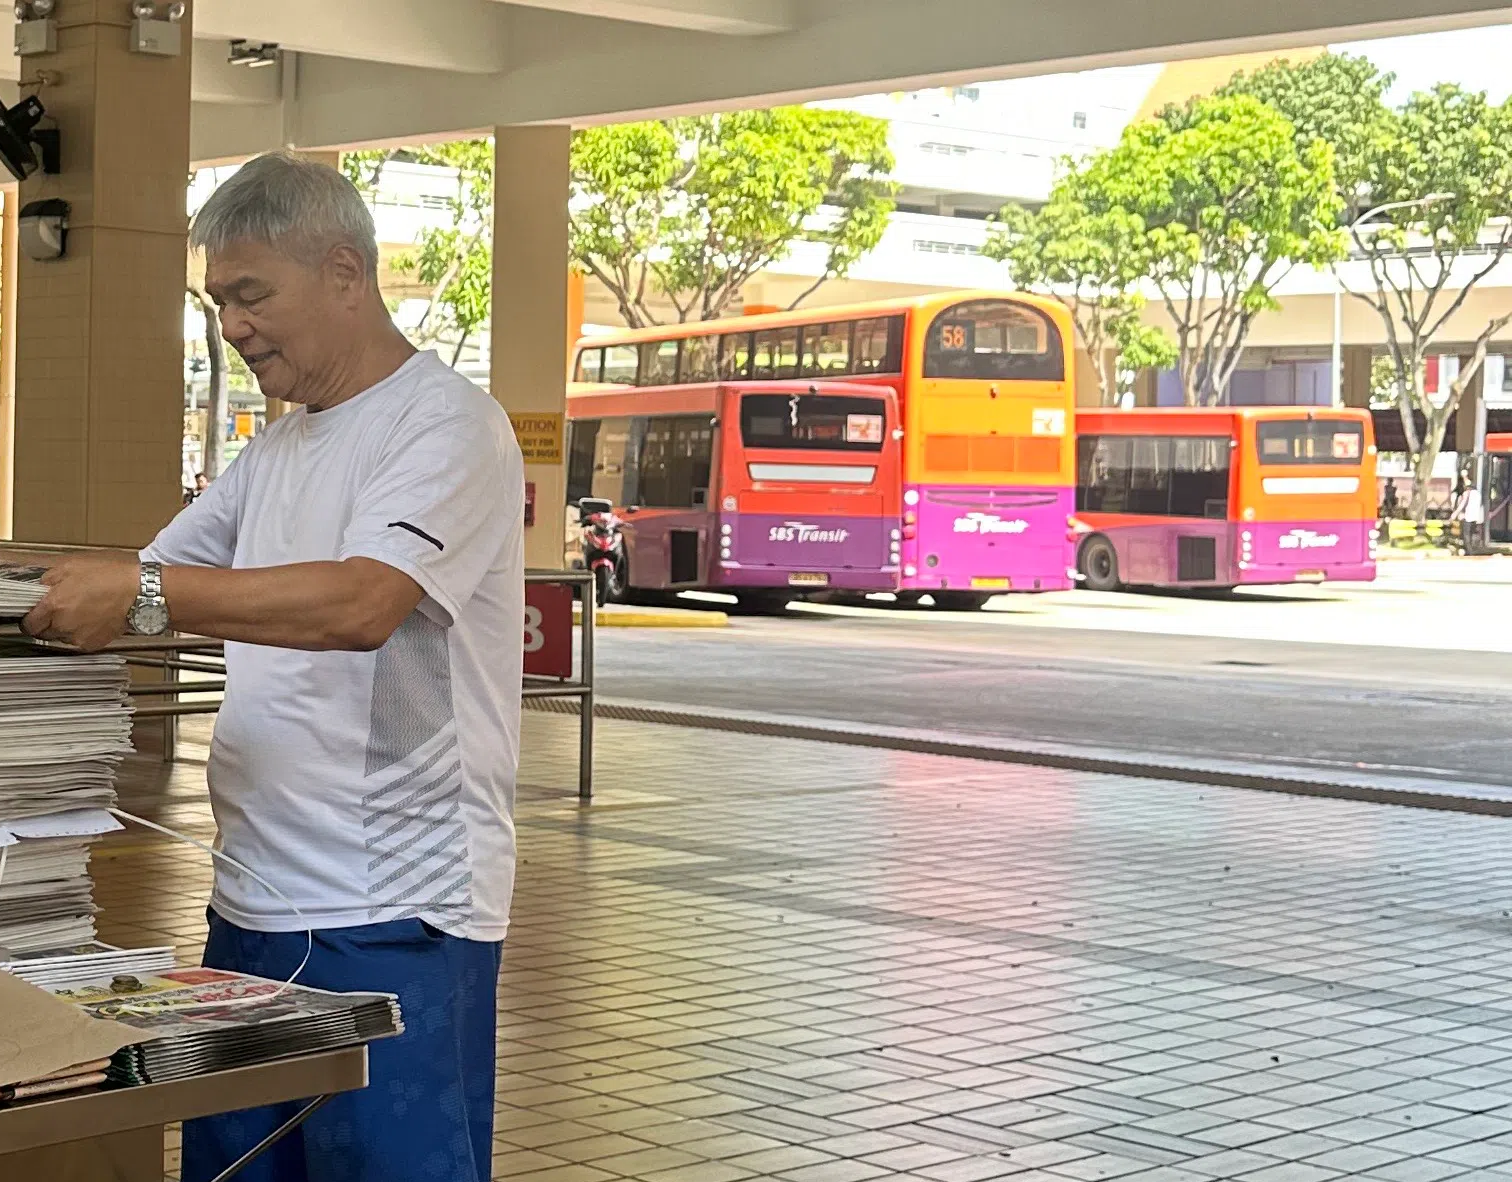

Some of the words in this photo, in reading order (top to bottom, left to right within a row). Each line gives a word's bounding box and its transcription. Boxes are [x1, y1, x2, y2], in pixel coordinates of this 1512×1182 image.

[942, 325, 964, 349] 58
[769, 527, 794, 542] SBS
[784, 521, 851, 543] Transit
